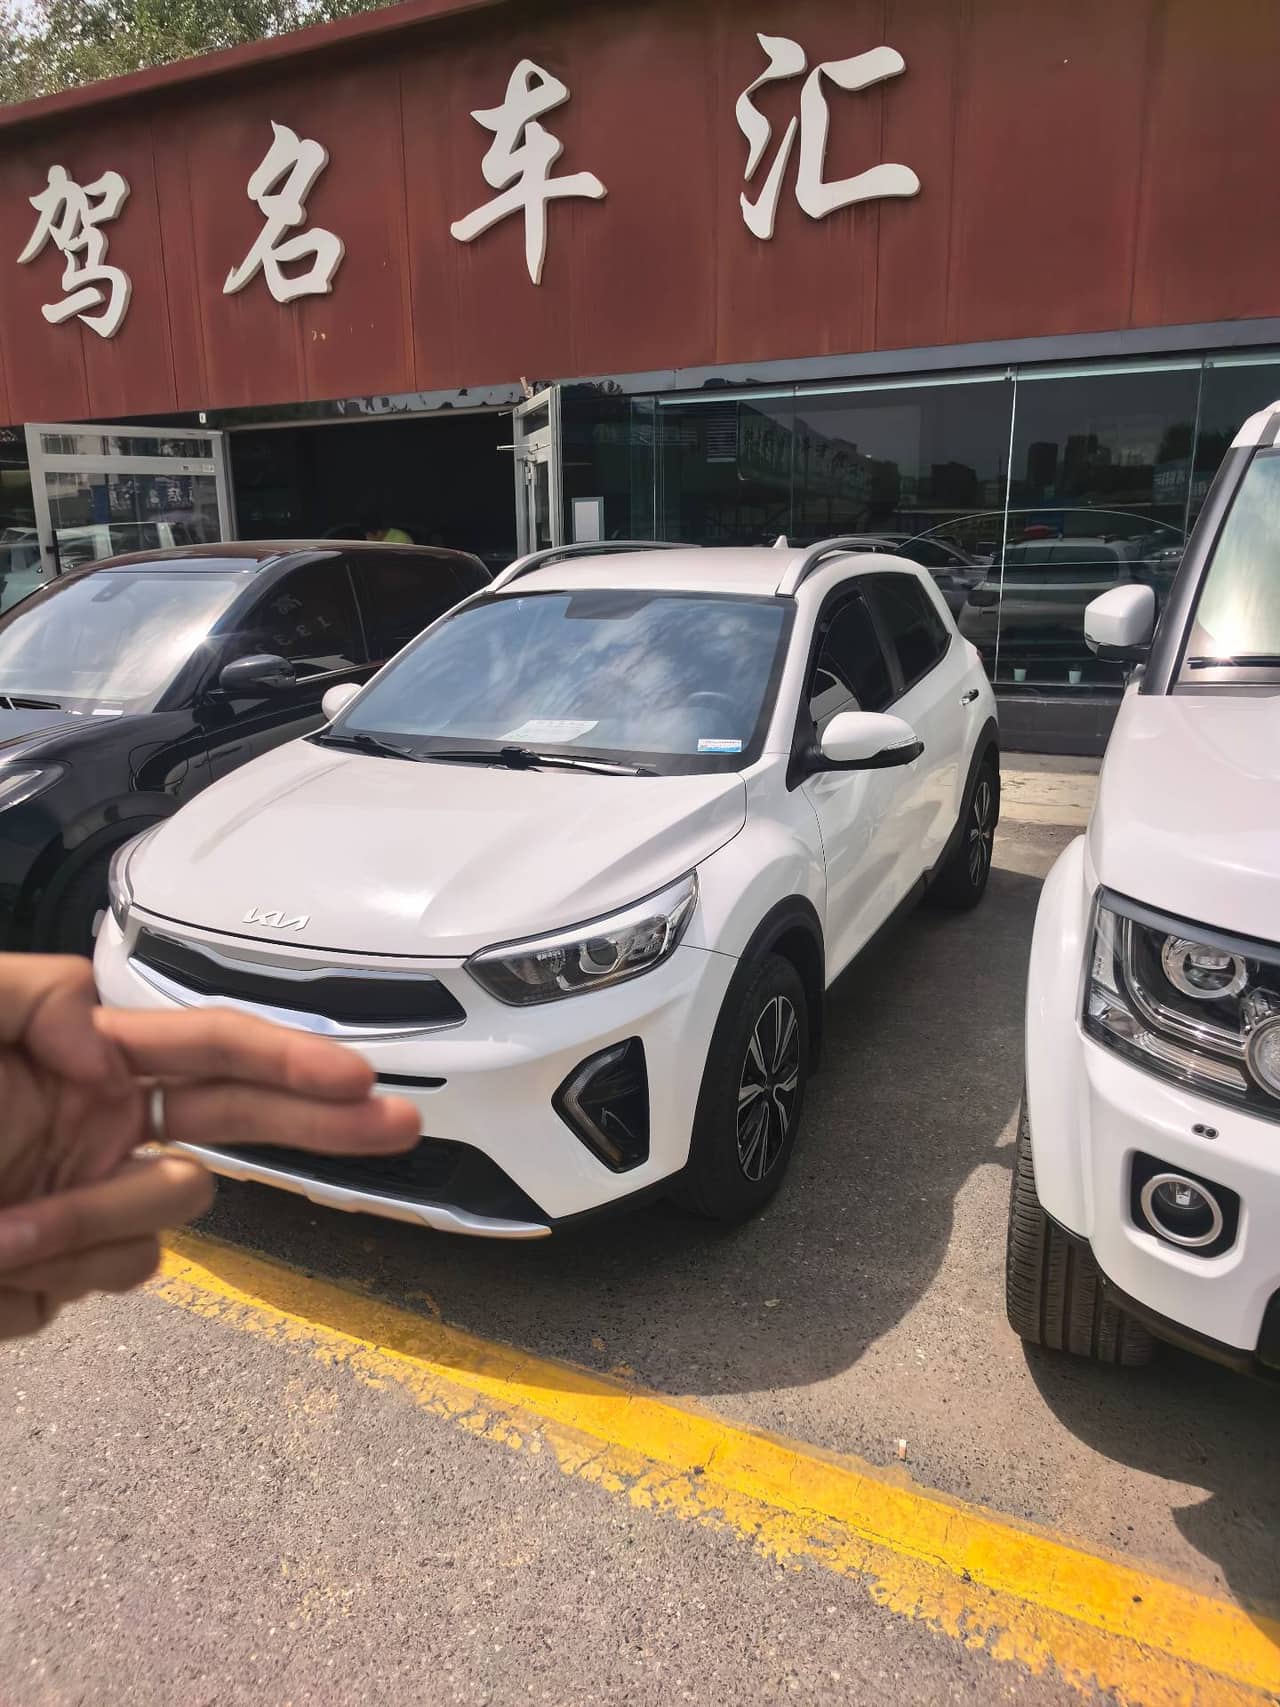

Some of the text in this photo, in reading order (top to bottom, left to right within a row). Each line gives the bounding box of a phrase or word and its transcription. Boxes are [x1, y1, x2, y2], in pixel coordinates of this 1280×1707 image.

[16, 32, 921, 339] 驾名车汇
[240, 905, 310, 932] KIA
